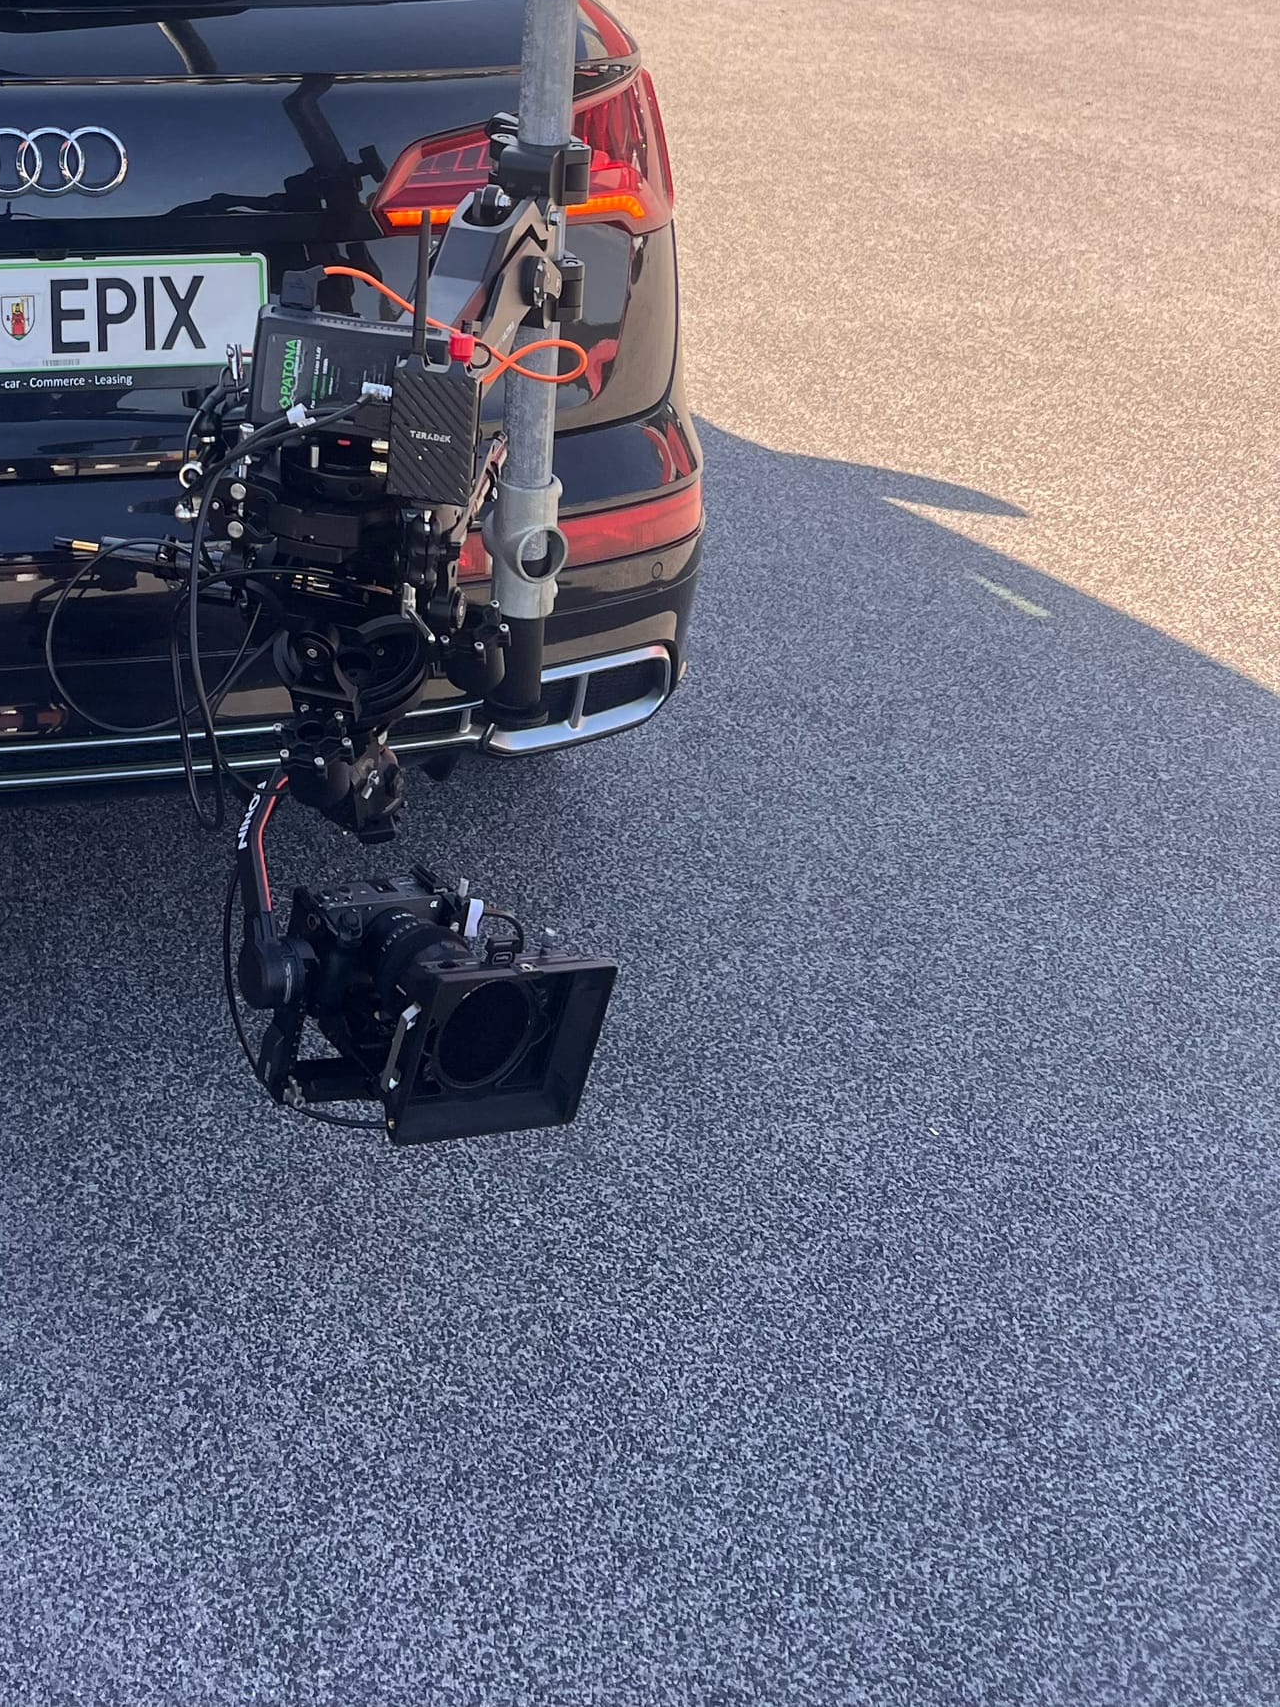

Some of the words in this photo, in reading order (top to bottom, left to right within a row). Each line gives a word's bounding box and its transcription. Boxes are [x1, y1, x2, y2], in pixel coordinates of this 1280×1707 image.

[50, 275, 206, 354] EPIX
[29, 377, 85, 389] Commerce
[95, 374, 133, 387] Leasing
[280, 339, 297, 396] PATONA
[409, 429, 452, 444] TERADEK
